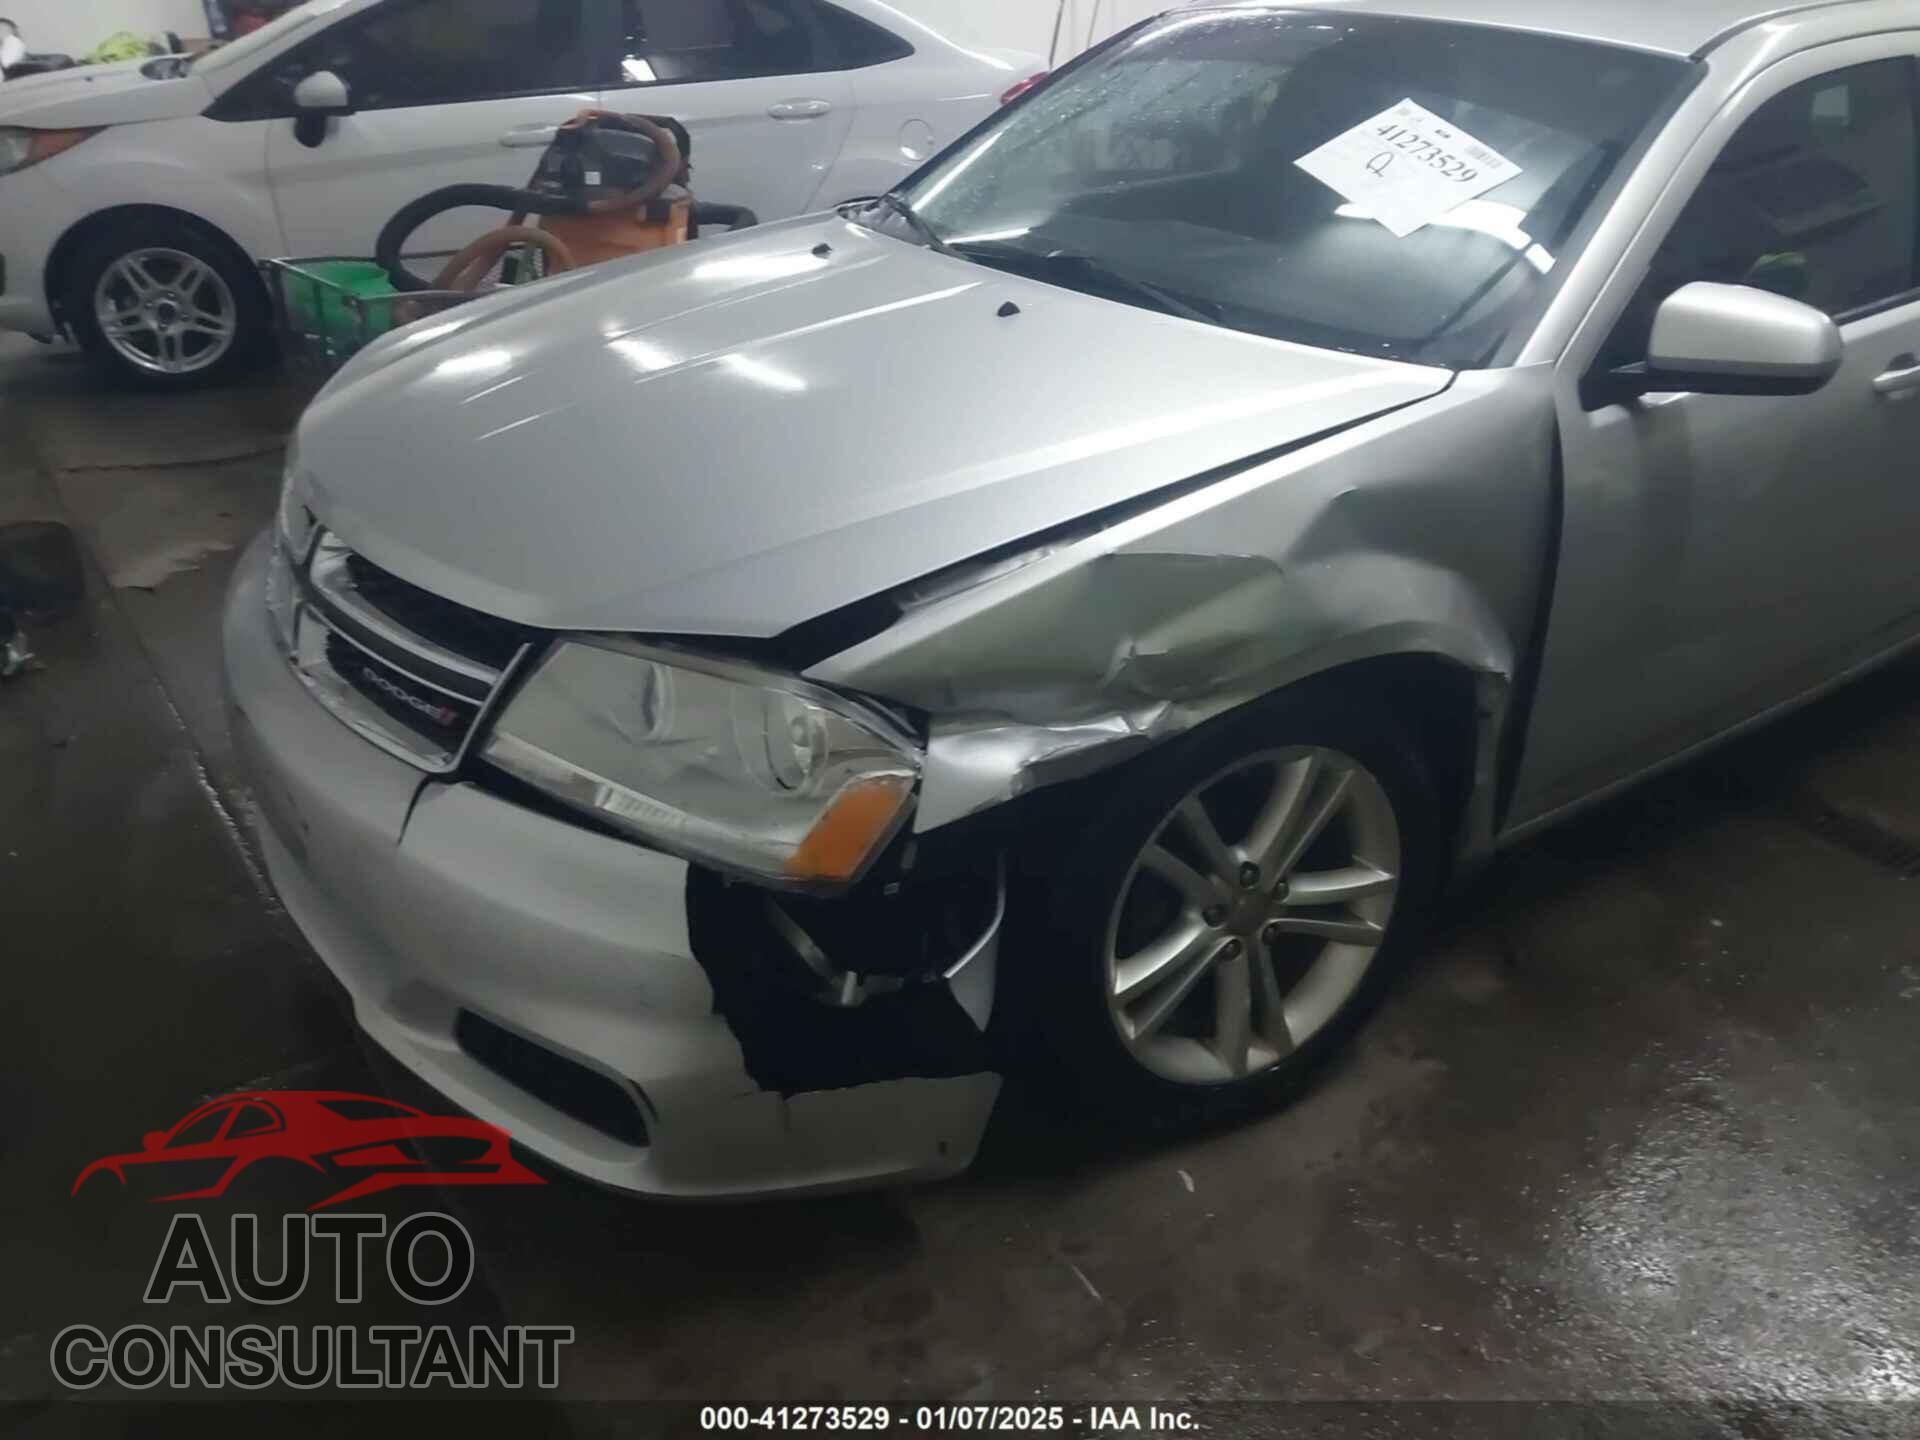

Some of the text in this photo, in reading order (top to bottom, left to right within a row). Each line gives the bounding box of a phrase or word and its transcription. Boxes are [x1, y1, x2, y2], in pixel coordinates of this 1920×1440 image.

[1365, 151, 1395, 178] Q
[1376, 124, 1480, 183] 41273529
[363, 667, 440, 719] DODGE
